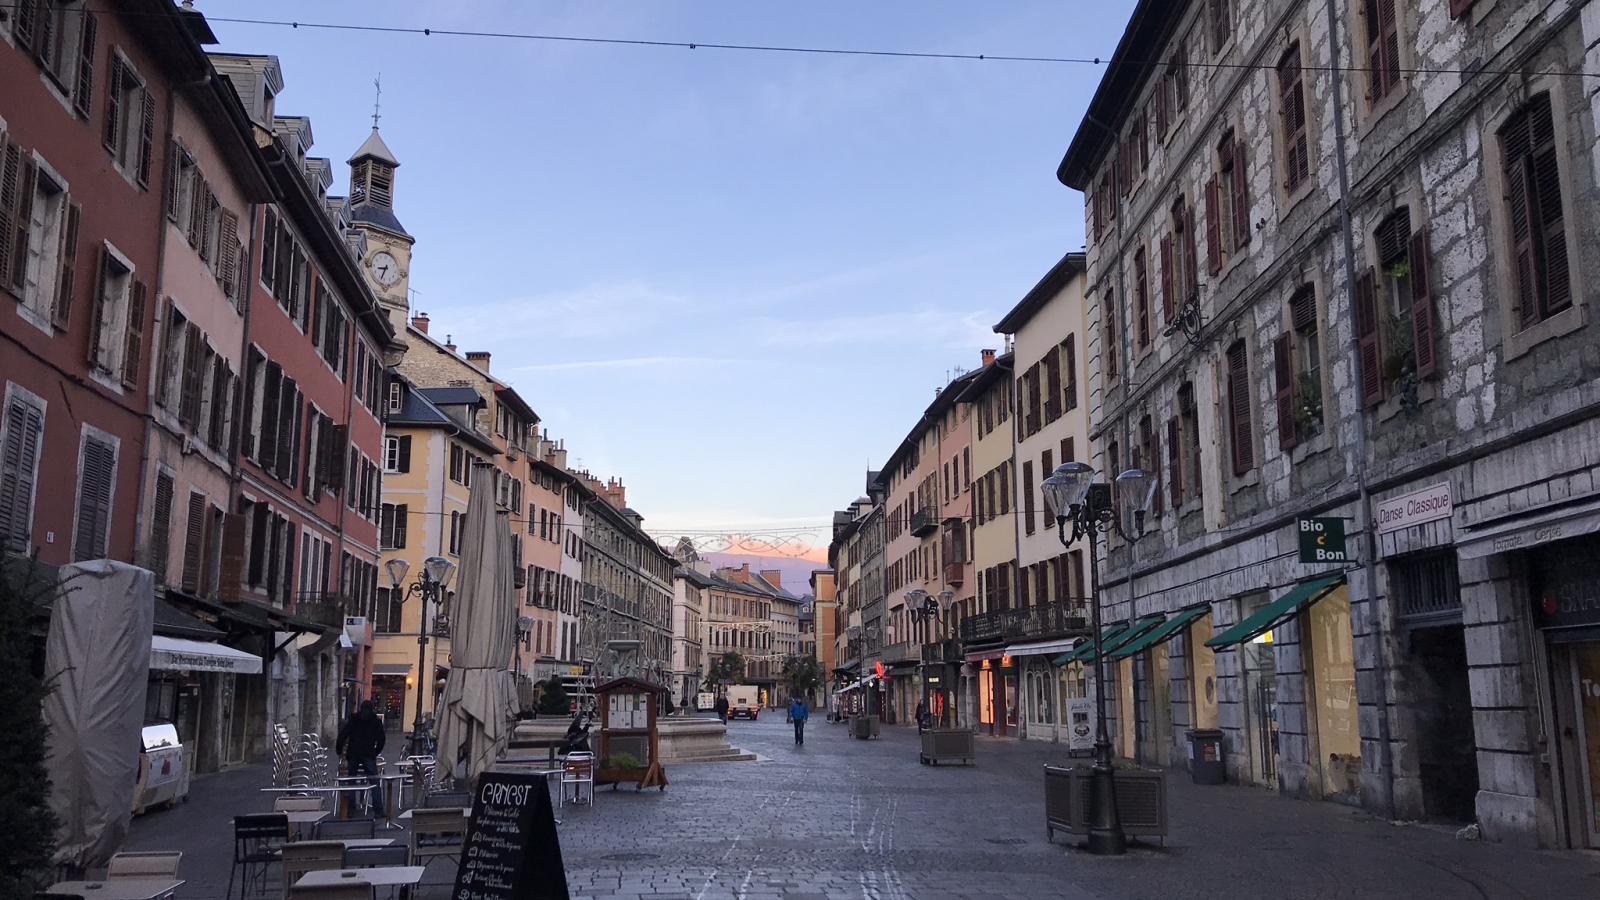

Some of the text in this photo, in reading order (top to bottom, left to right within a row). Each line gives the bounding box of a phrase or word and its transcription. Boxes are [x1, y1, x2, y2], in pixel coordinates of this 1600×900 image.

[1380, 494, 1449, 524] Danse Classique
[1300, 519, 1324, 532] Bio
[1316, 548, 1345, 561] Bon
